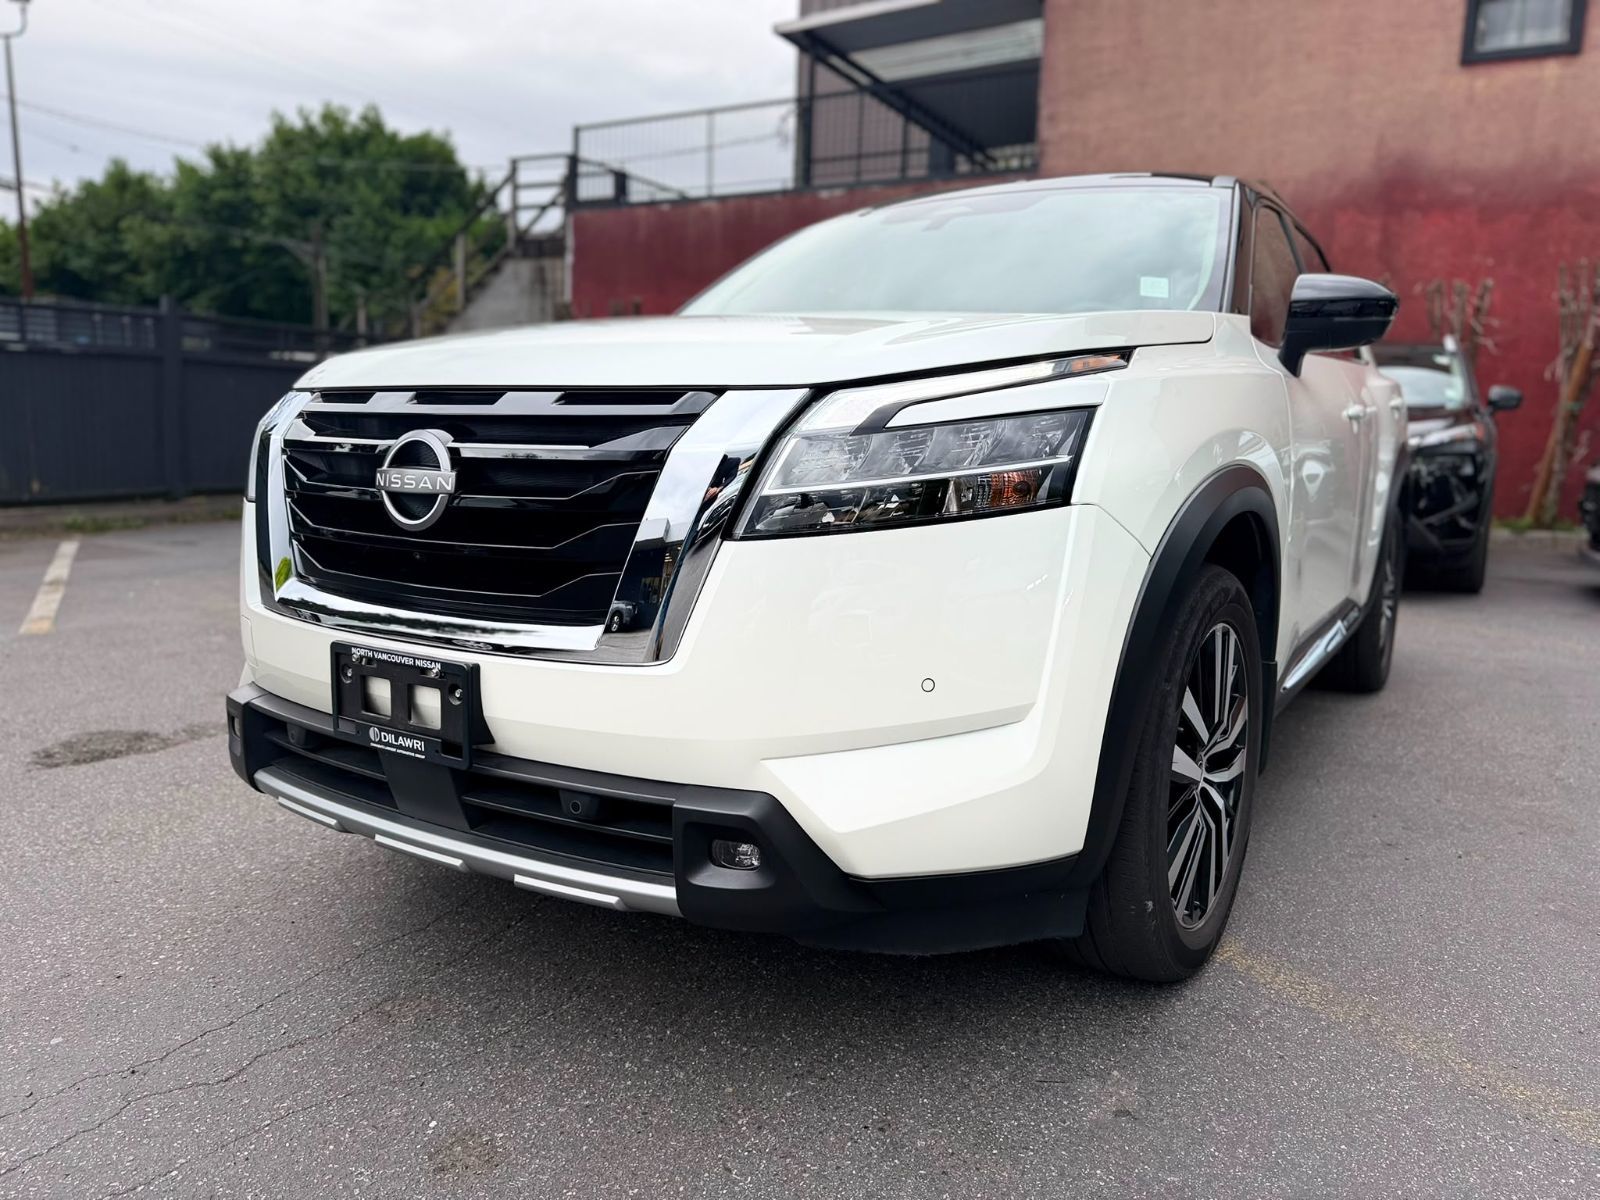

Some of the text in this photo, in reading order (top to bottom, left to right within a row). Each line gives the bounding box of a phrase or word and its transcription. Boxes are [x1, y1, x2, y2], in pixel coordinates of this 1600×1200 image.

[376, 473, 452, 491] NISSAN
[351, 646, 441, 670] NORTH VANCOUVER NISSAN
[381, 731, 425, 752] DILAWRI
